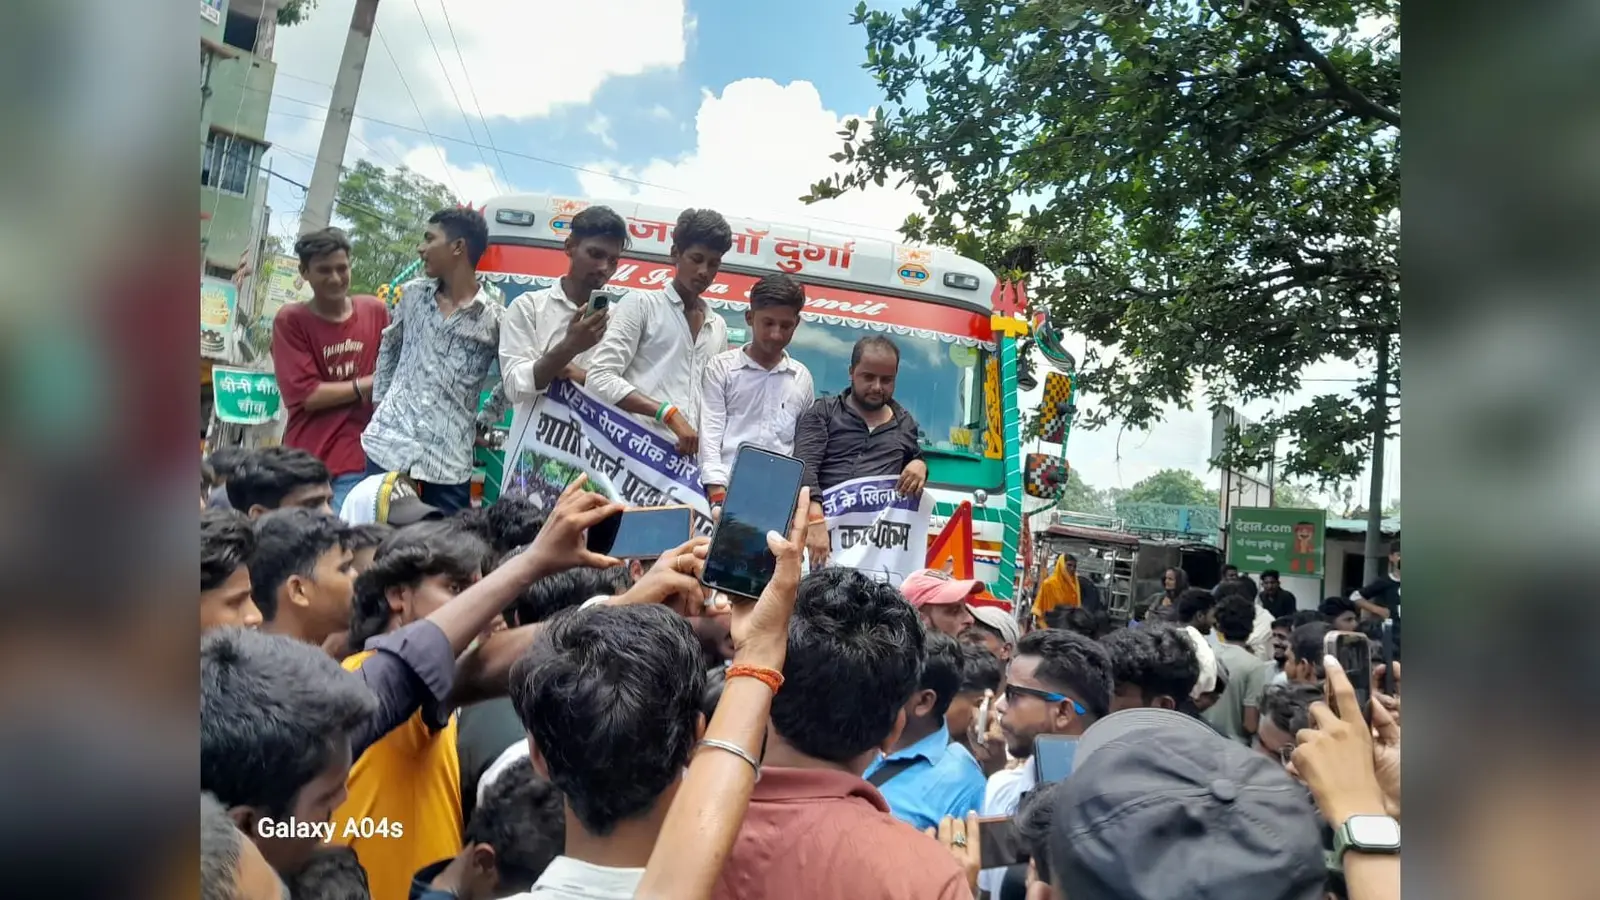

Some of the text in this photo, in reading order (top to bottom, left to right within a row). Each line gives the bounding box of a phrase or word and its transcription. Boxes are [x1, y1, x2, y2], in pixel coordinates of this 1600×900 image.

[608, 263, 639, 283] ll
[774, 237, 856, 274] दुर्गा
[599, 410, 629, 443] पेपर
[628, 433, 667, 463] लीक
[665, 455, 699, 481] और
[840, 489, 857, 508] के
